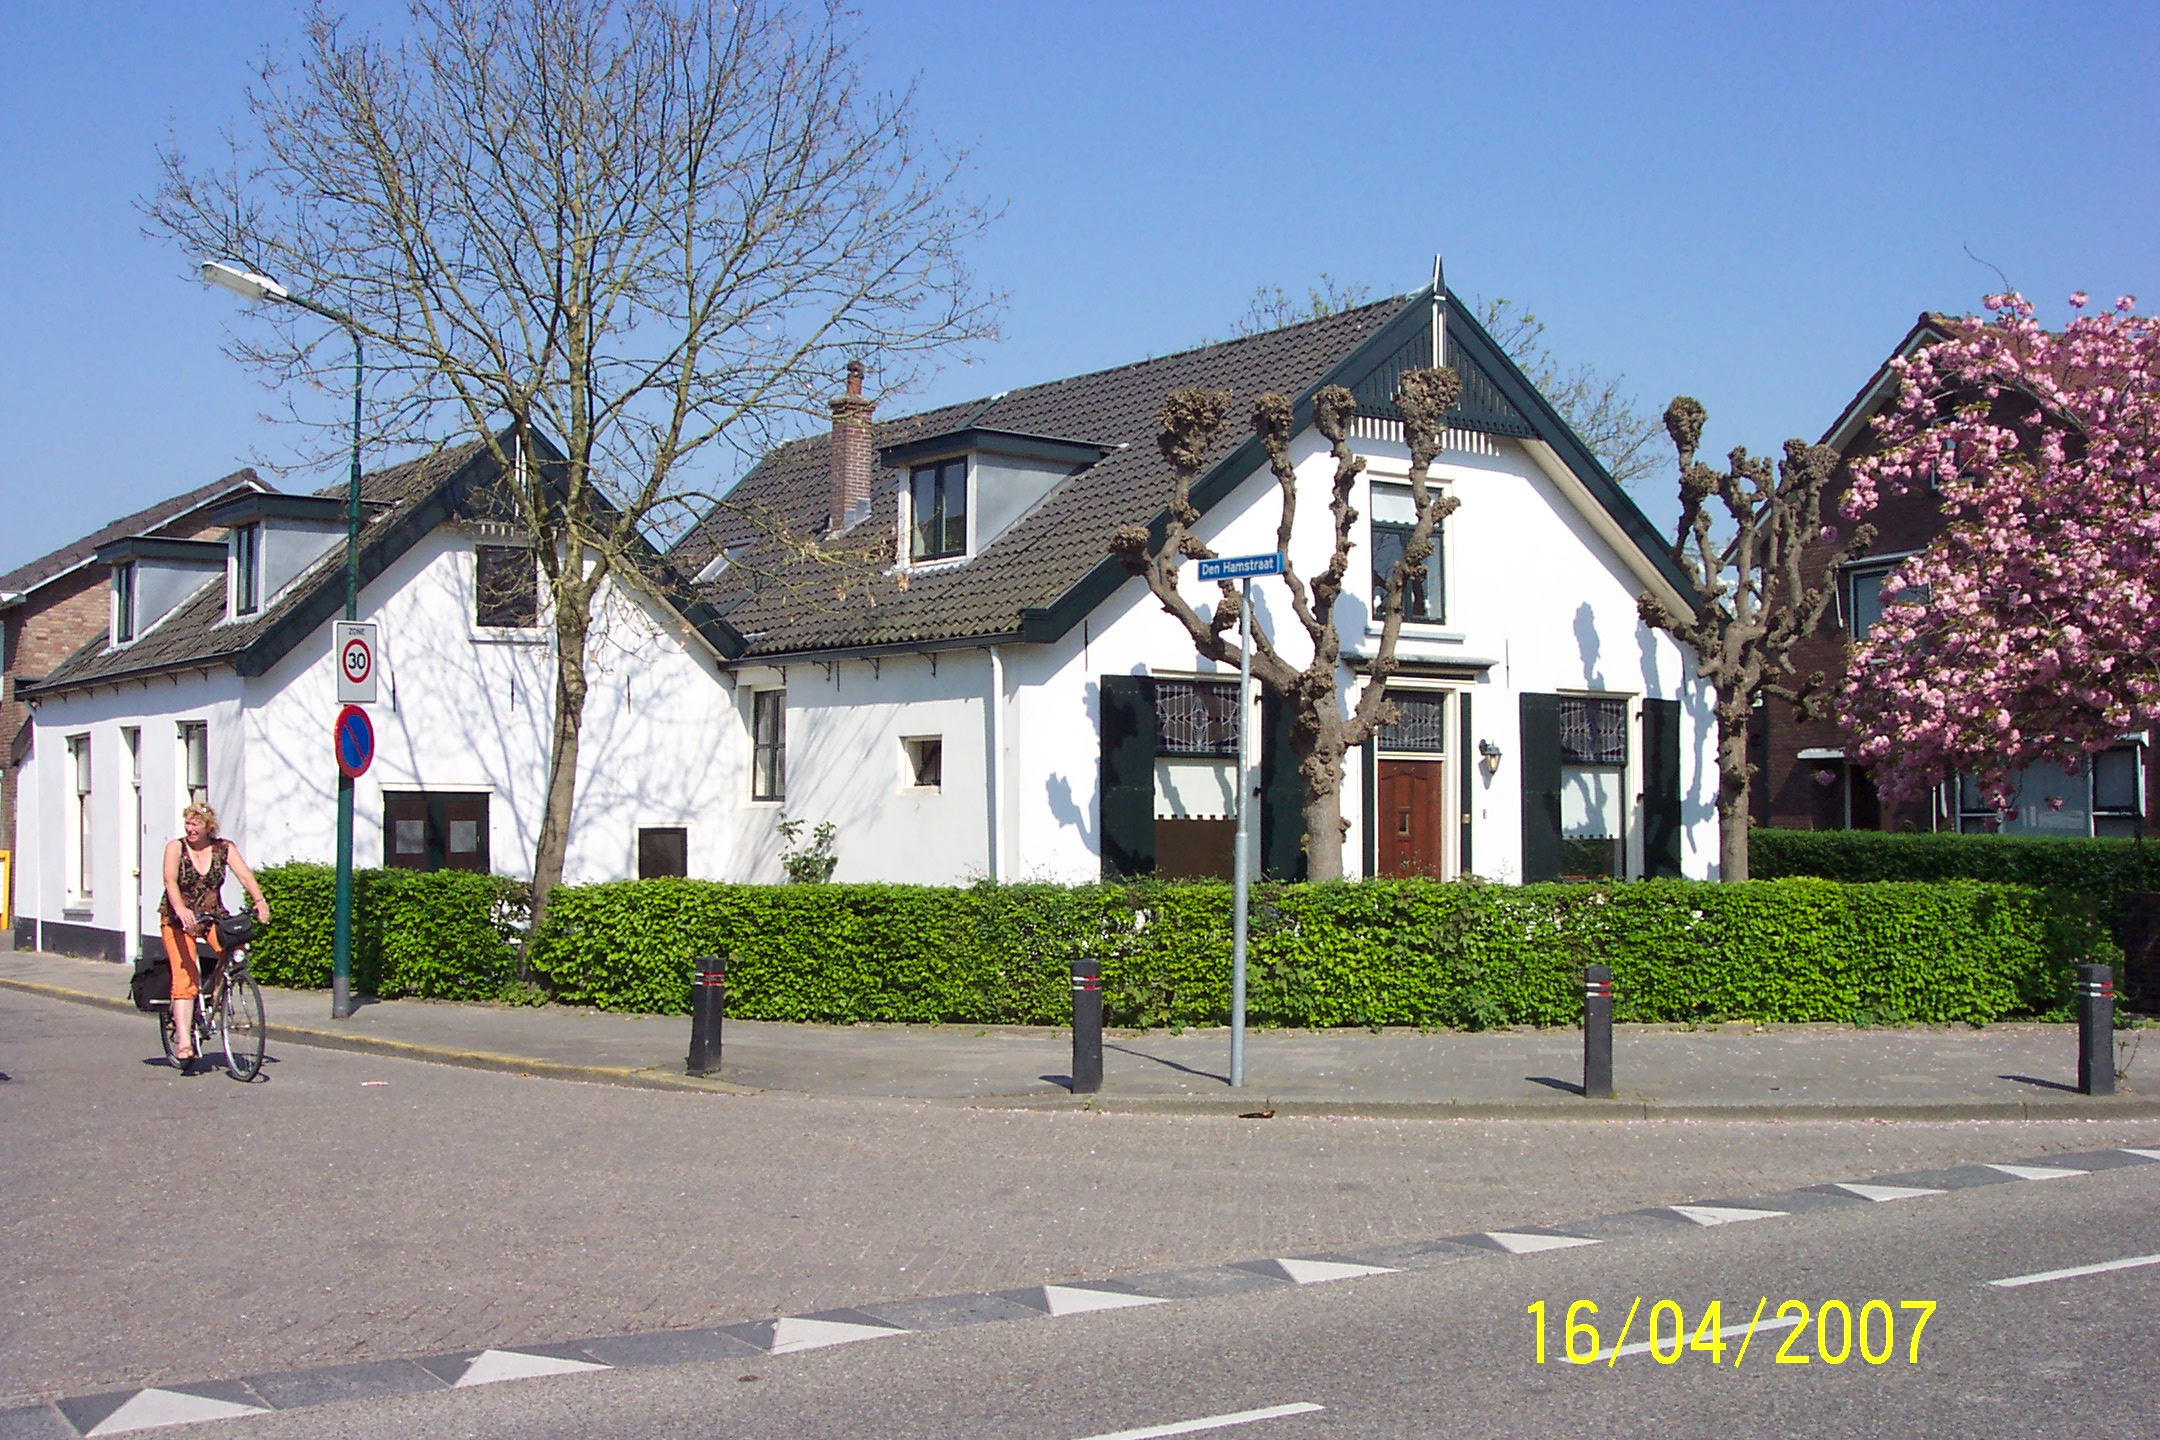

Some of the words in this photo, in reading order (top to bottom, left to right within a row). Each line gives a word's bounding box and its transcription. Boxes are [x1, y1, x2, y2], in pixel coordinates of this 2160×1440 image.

[1202, 564, 1220, 576] Den
[1222, 557, 1275, 573] Hamstraat
[348, 627, 366, 636] ZONE
[348, 652, 366, 670] 30
